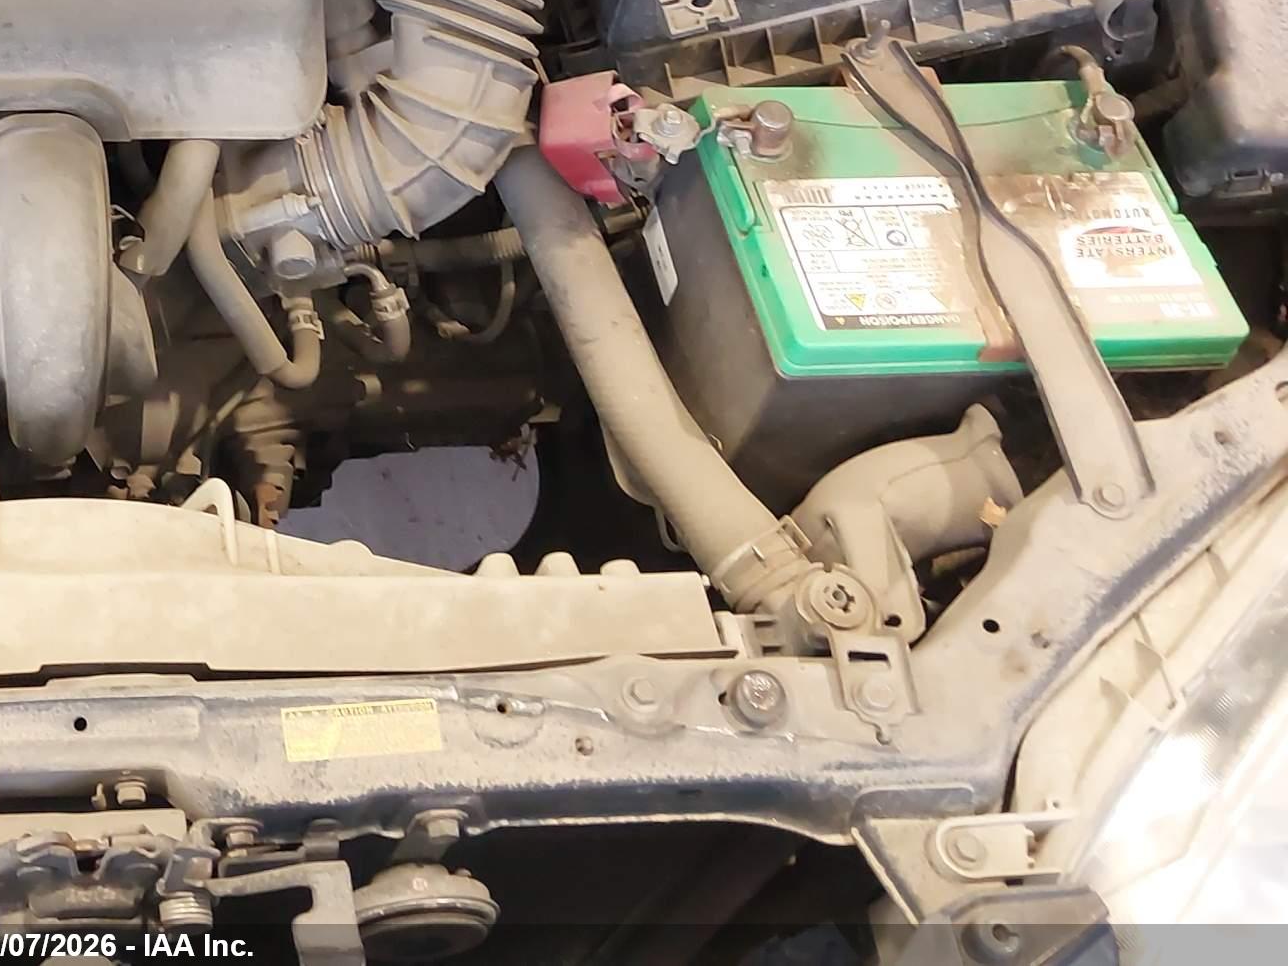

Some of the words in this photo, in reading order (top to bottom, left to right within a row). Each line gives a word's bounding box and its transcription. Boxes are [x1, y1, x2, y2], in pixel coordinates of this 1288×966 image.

[1059, 207, 1151, 221] AUTOMOTE
[1075, 234, 1164, 246] BATTERIES
[1074, 244, 1176, 259] INTERSATE
